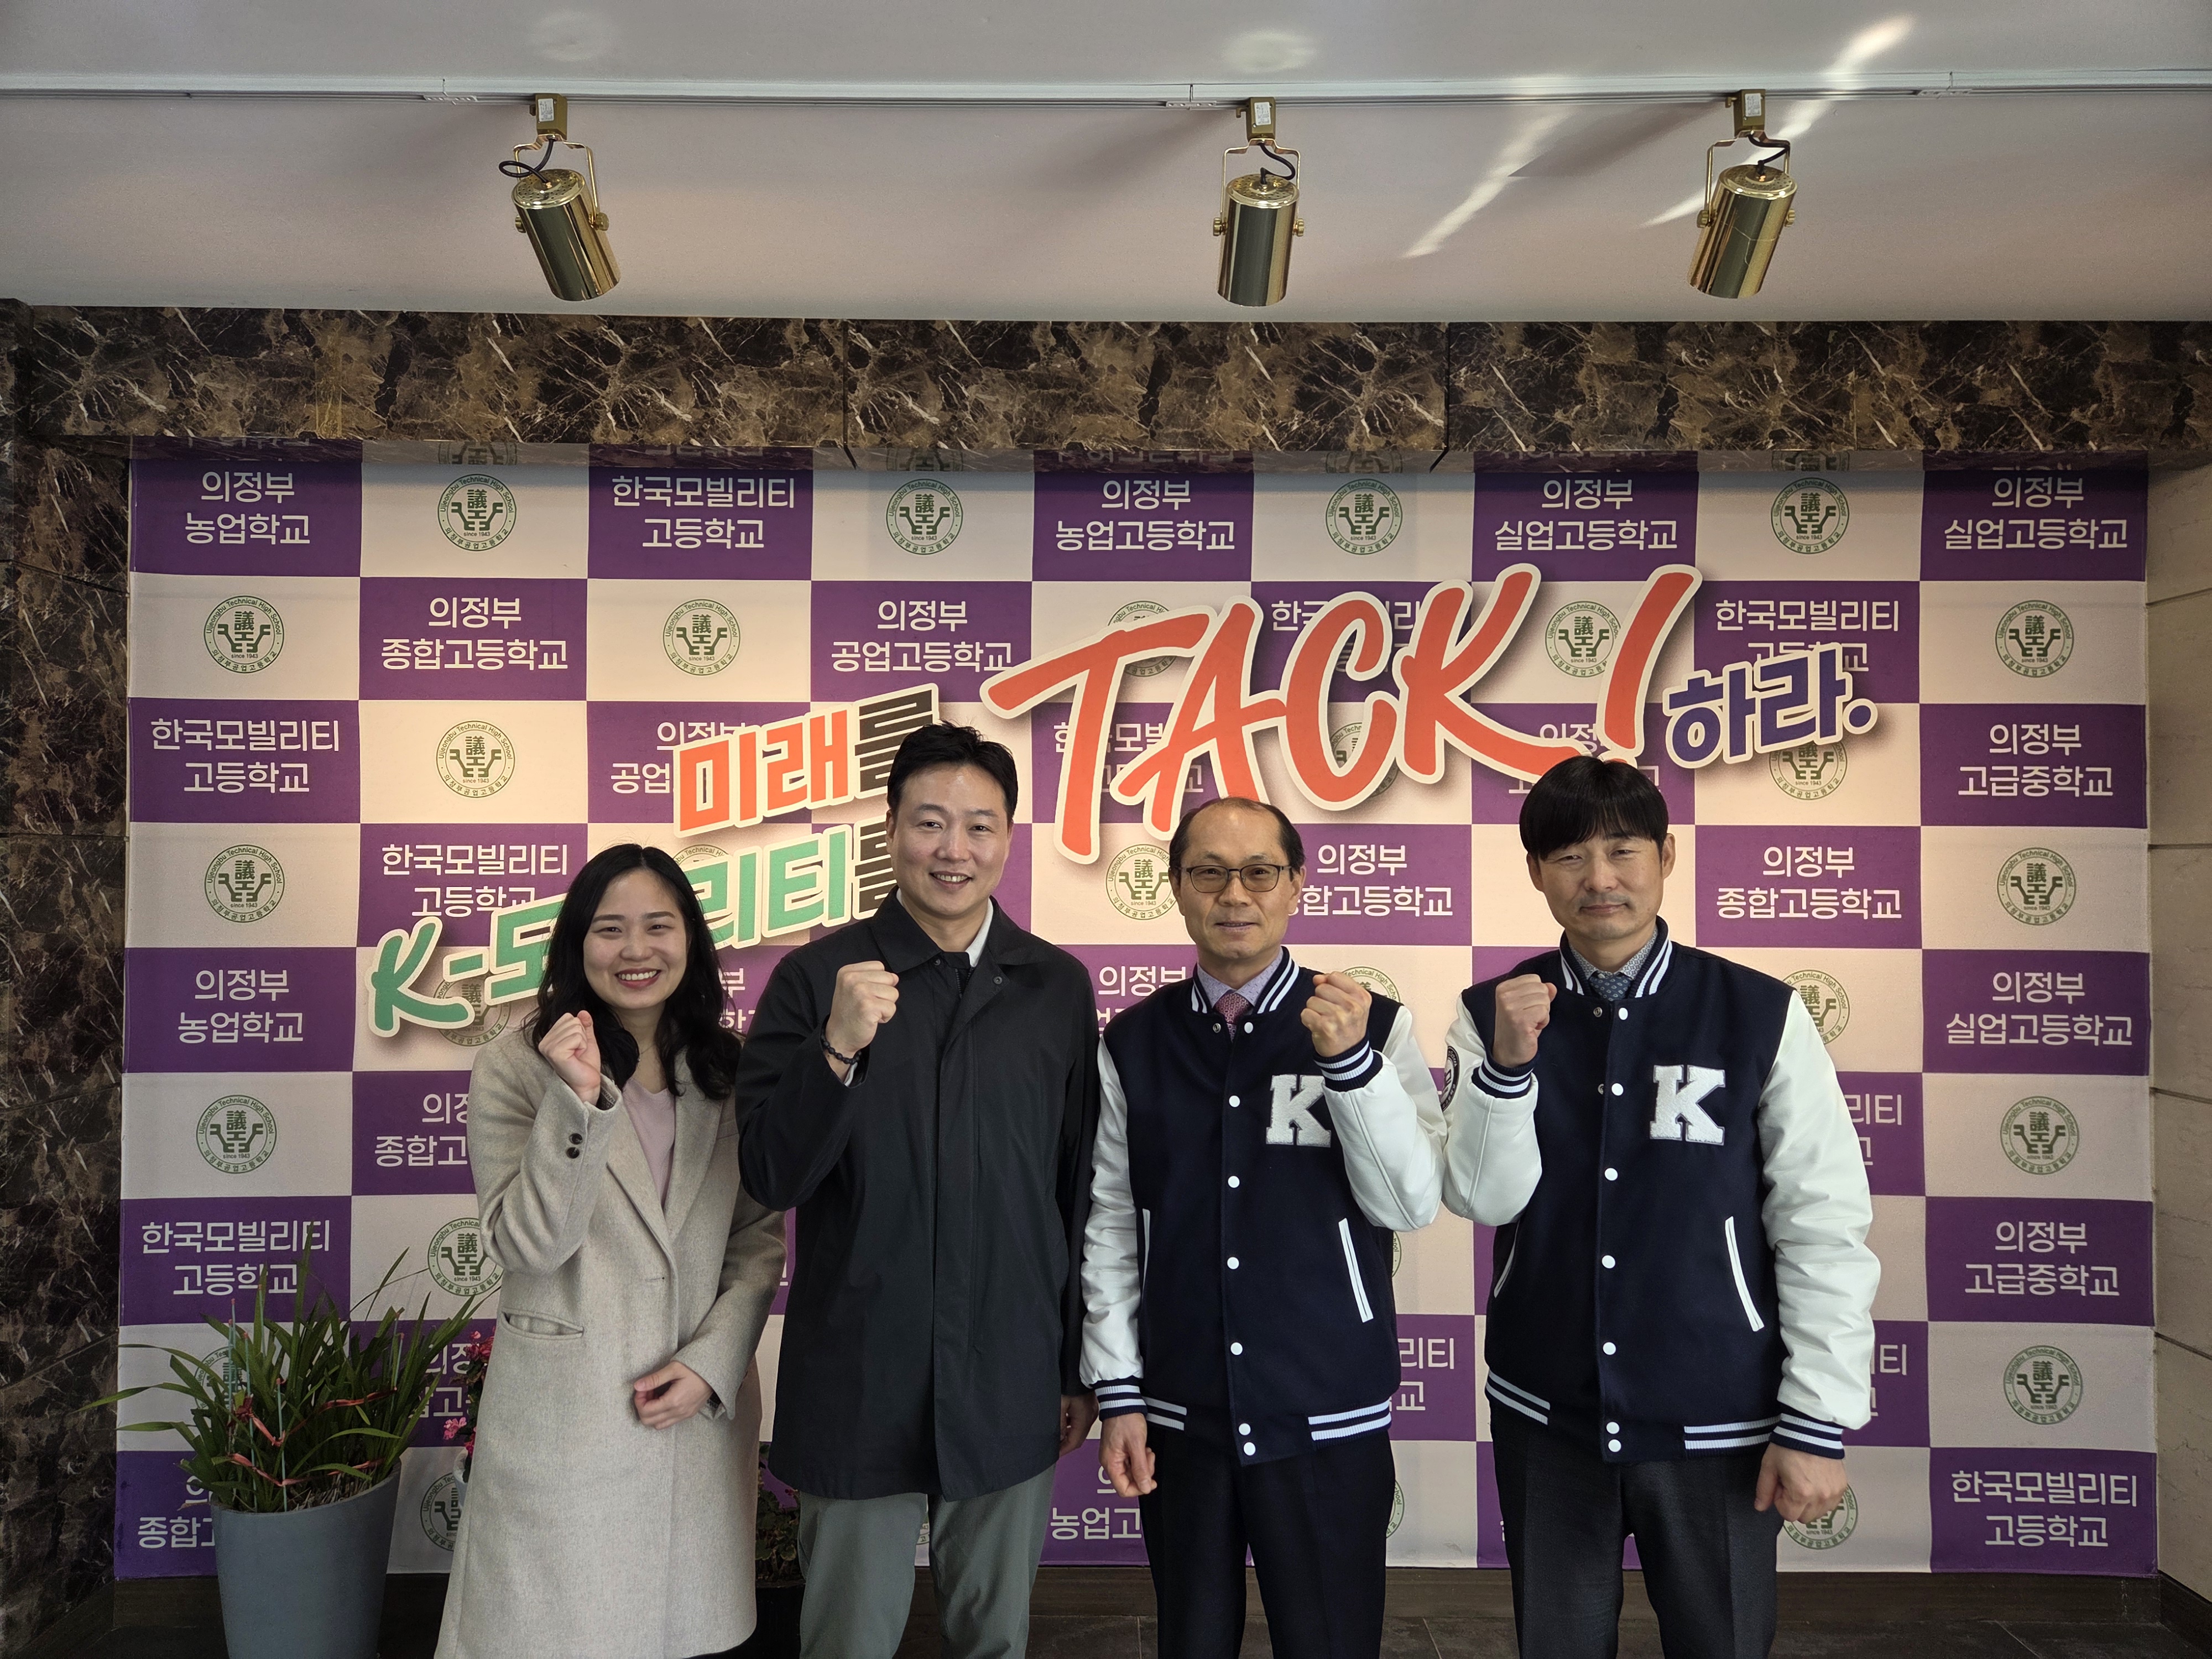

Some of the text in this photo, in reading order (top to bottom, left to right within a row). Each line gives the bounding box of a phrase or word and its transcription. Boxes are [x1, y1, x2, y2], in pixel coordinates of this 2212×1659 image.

[201, 472, 294, 503] 의정부
[458, 477, 489, 486] Technical
[490, 480, 503, 492] High
[503, 492, 514, 513] School
[613, 476, 794, 508] 한국모빌리티
[907, 482, 937, 490] Technical
[938, 485, 951, 497] High
[950, 497, 961, 518] School
[1102, 481, 1191, 510] 의정부
[1542, 479, 1632, 509] 의정부
[1992, 477, 2084, 508] 의정부
[185, 513, 310, 544] 농업학교
[643, 518, 764, 549] 고등학교
[1056, 520, 1234, 550] 농업고등학교
[1495, 520, 1677, 550] 실업고등학교
[1945, 519, 2127, 549] 실업고등학교
[226, 598, 257, 607] Technical
[258, 602, 271, 613] High
[270, 613, 282, 634] School
[429, 597, 521, 629] 의정부
[684, 601, 714, 610] Technical
[714, 604, 728, 617] High
[727, 617, 738, 638] School
[878, 601, 967, 632] 의정부
[1566, 603, 1597, 612] Technical
[1598, 607, 1610, 619] High
[1716, 600, 1898, 631] 한국모빌리티
[382, 639, 567, 670] 종합고등학교
[831, 641, 1014, 672] 공업고등학교
[1662, 643, 1879, 769] 하라.
[151, 718, 338, 751] 한국모빌리티
[457, 723, 488, 732] Technical
[489, 727, 502, 739] High
[502, 738, 513, 759] School
[1990, 724, 2081, 755] 의정부
[184, 762, 309, 793] 고등학교
[1958, 766, 2113, 797] 고급중학교
[226, 847, 258, 855] Technical
[258, 851, 272, 863] High
[271, 862, 283, 884] School
[382, 844, 567, 875] 한국모빌리티
[1126, 847, 1157, 855] Technical
[1317, 844, 1407, 875] 의정부
[1763, 847, 1854, 878] 의정부
[1288, 885, 1453, 916] 합고등학교
[1717, 888, 1901, 919] 종합고등학교
[195, 969, 289, 1001] 의정부
[1388, 984, 1397, 1000] Scho
[1792, 972, 1846, 1009] Technical High School
[1992, 972, 2085, 1004] 의정부
[179, 1012, 303, 1043] 농업학교
[1947, 1014, 2132, 1046] 실업고등학교
[218, 1098, 249, 1107] Technical
[250, 1102, 263, 1114] High
[263, 1113, 274, 1135] School
[1266, 1074, 1331, 1147] K
[1650, 1065, 1726, 1146] K
[374, 1135, 468, 1166] 종합고
[142, 1220, 329, 1253] 한국모빌리티
[449, 1220, 479, 1230] Technica
[1995, 1222, 2087, 1254] 의정부
[1965, 1264, 2119, 1296] 고급중학교
[1952, 1470, 2136, 1506] 한국모빌리티
[1051, 1507, 1142, 1540] 농업고
[1985, 1515, 2108, 1547] 고등학교
